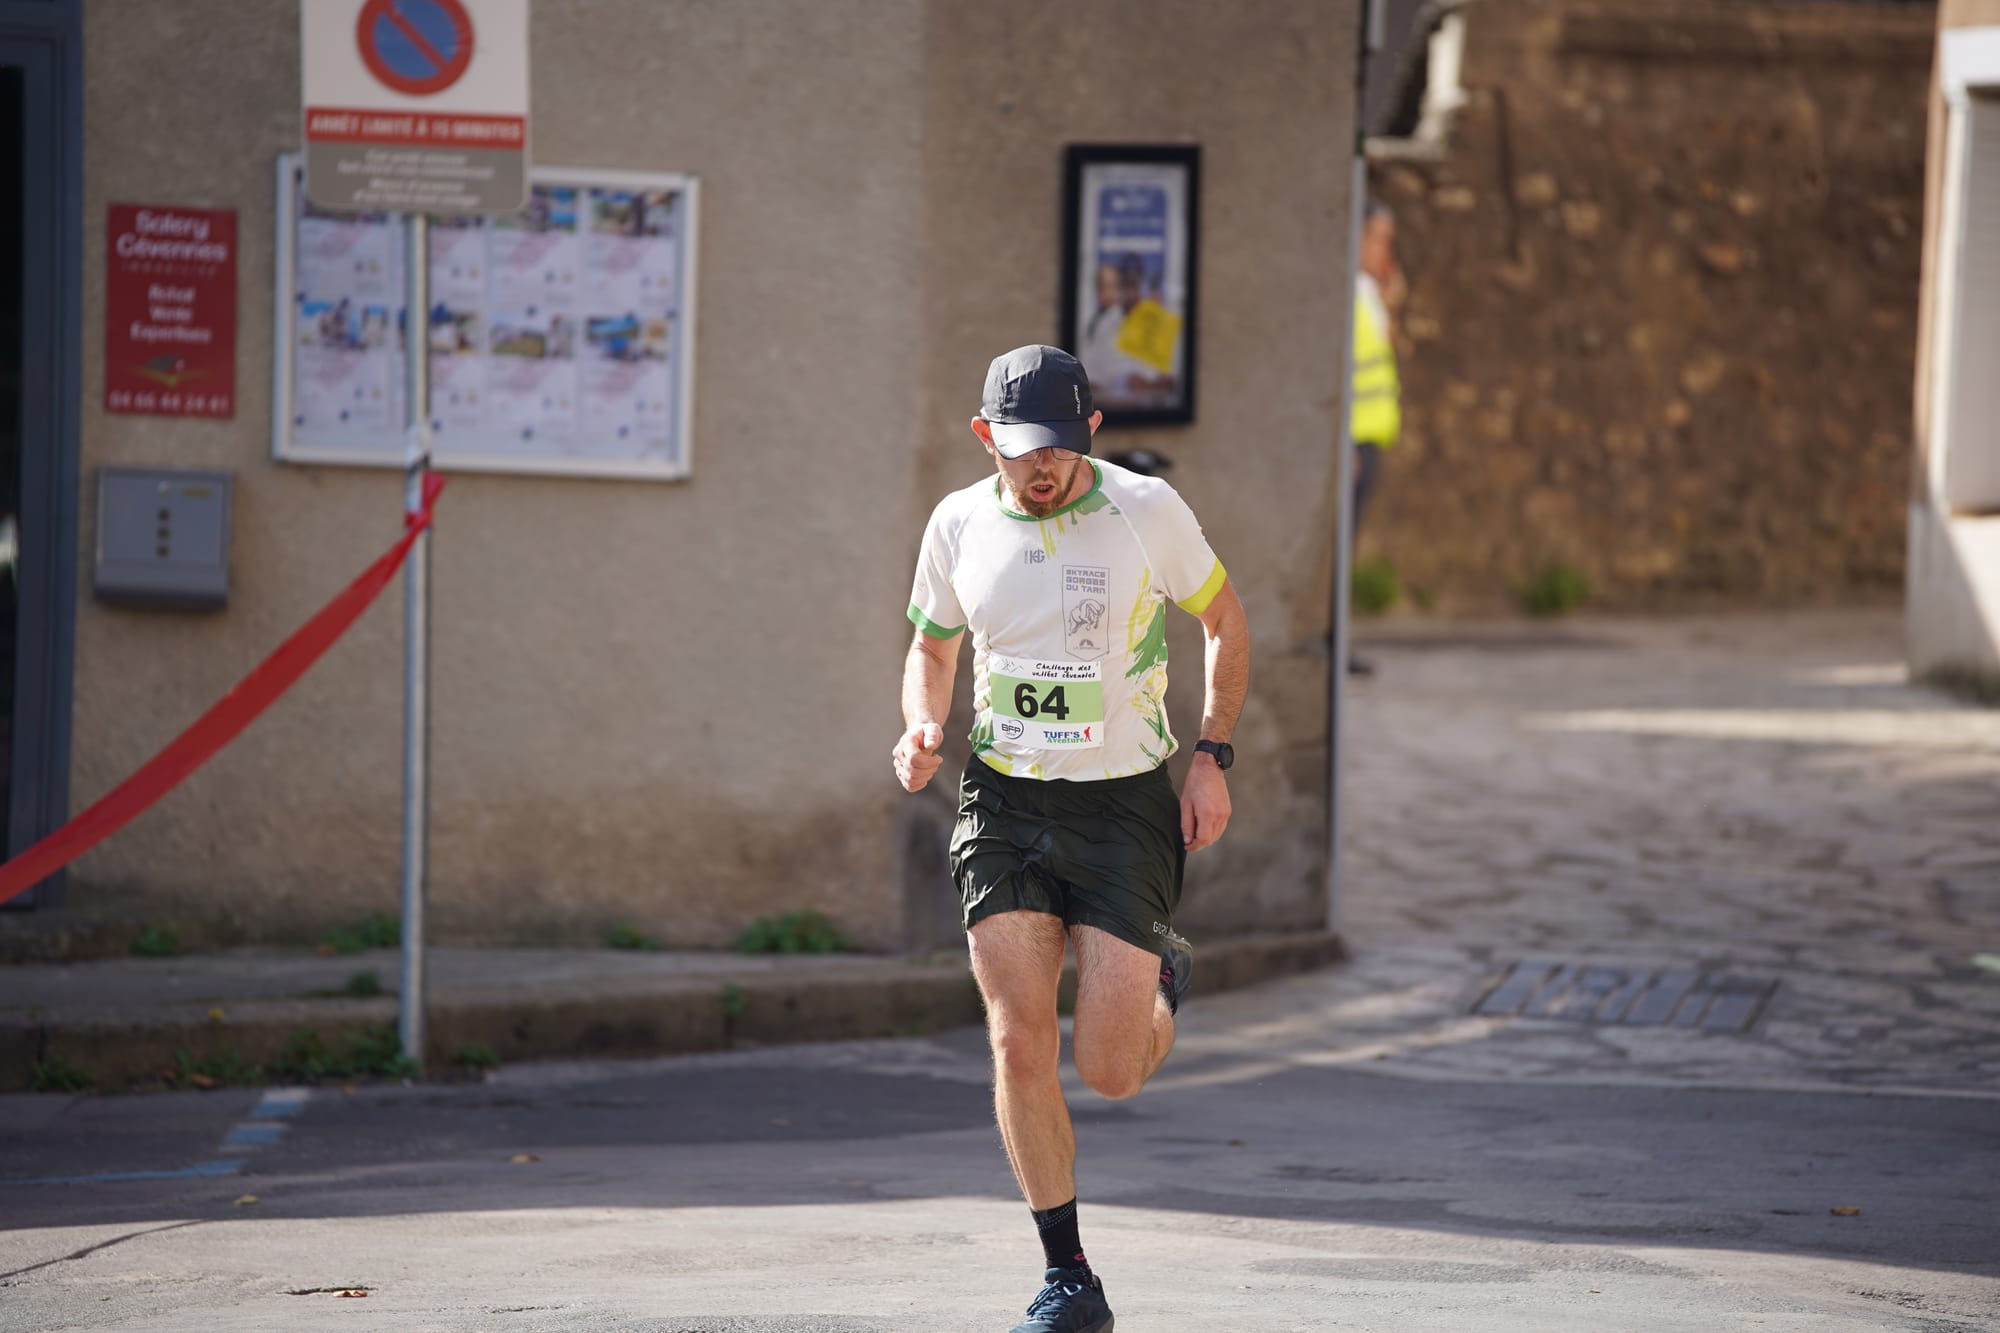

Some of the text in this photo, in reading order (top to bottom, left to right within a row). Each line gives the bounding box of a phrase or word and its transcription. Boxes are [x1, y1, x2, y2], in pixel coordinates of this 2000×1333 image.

[1066, 569, 1106, 578] SKYRACE
[1066, 576, 1106, 587] GORGES
[1066, 584, 1106, 595] DU TARN
[1035, 662, 1073, 673] Challenge
[1062, 671, 1096, 679] cévenoles
[1014, 682, 1070, 721] 64
[1043, 730, 1080, 739] TUFF'S
